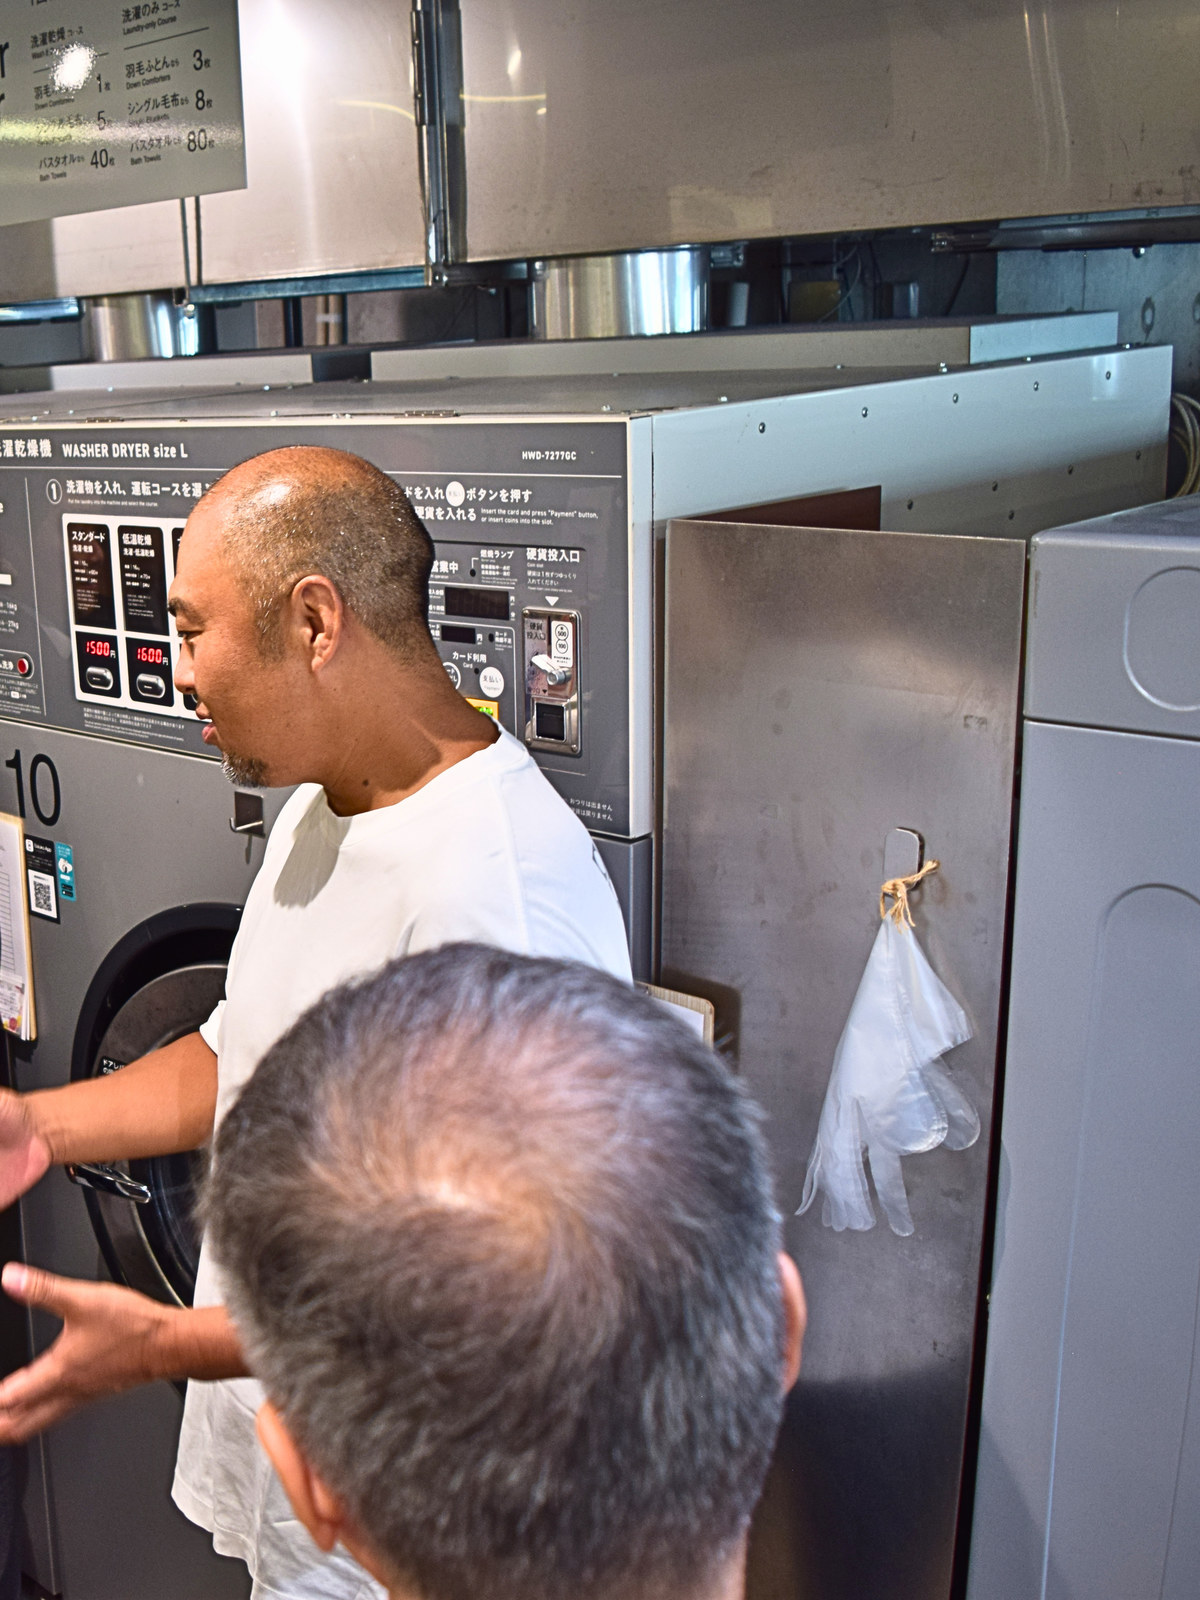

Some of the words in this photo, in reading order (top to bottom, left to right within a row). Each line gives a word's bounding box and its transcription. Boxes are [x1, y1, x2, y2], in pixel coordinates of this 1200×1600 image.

[62, 443, 109, 458] WASHER
[112, 443, 151, 458] DRYER
[153, 443, 177, 458] size
[180, 442, 189, 458] L
[522, 450, 577, 461] HWD-7277GC
[72, 531, 105, 543] スタンダード
[526, 547, 580, 563] 硬貨投入口
[452, 651, 487, 663] カード利用
[5, 749, 61, 827] 10
